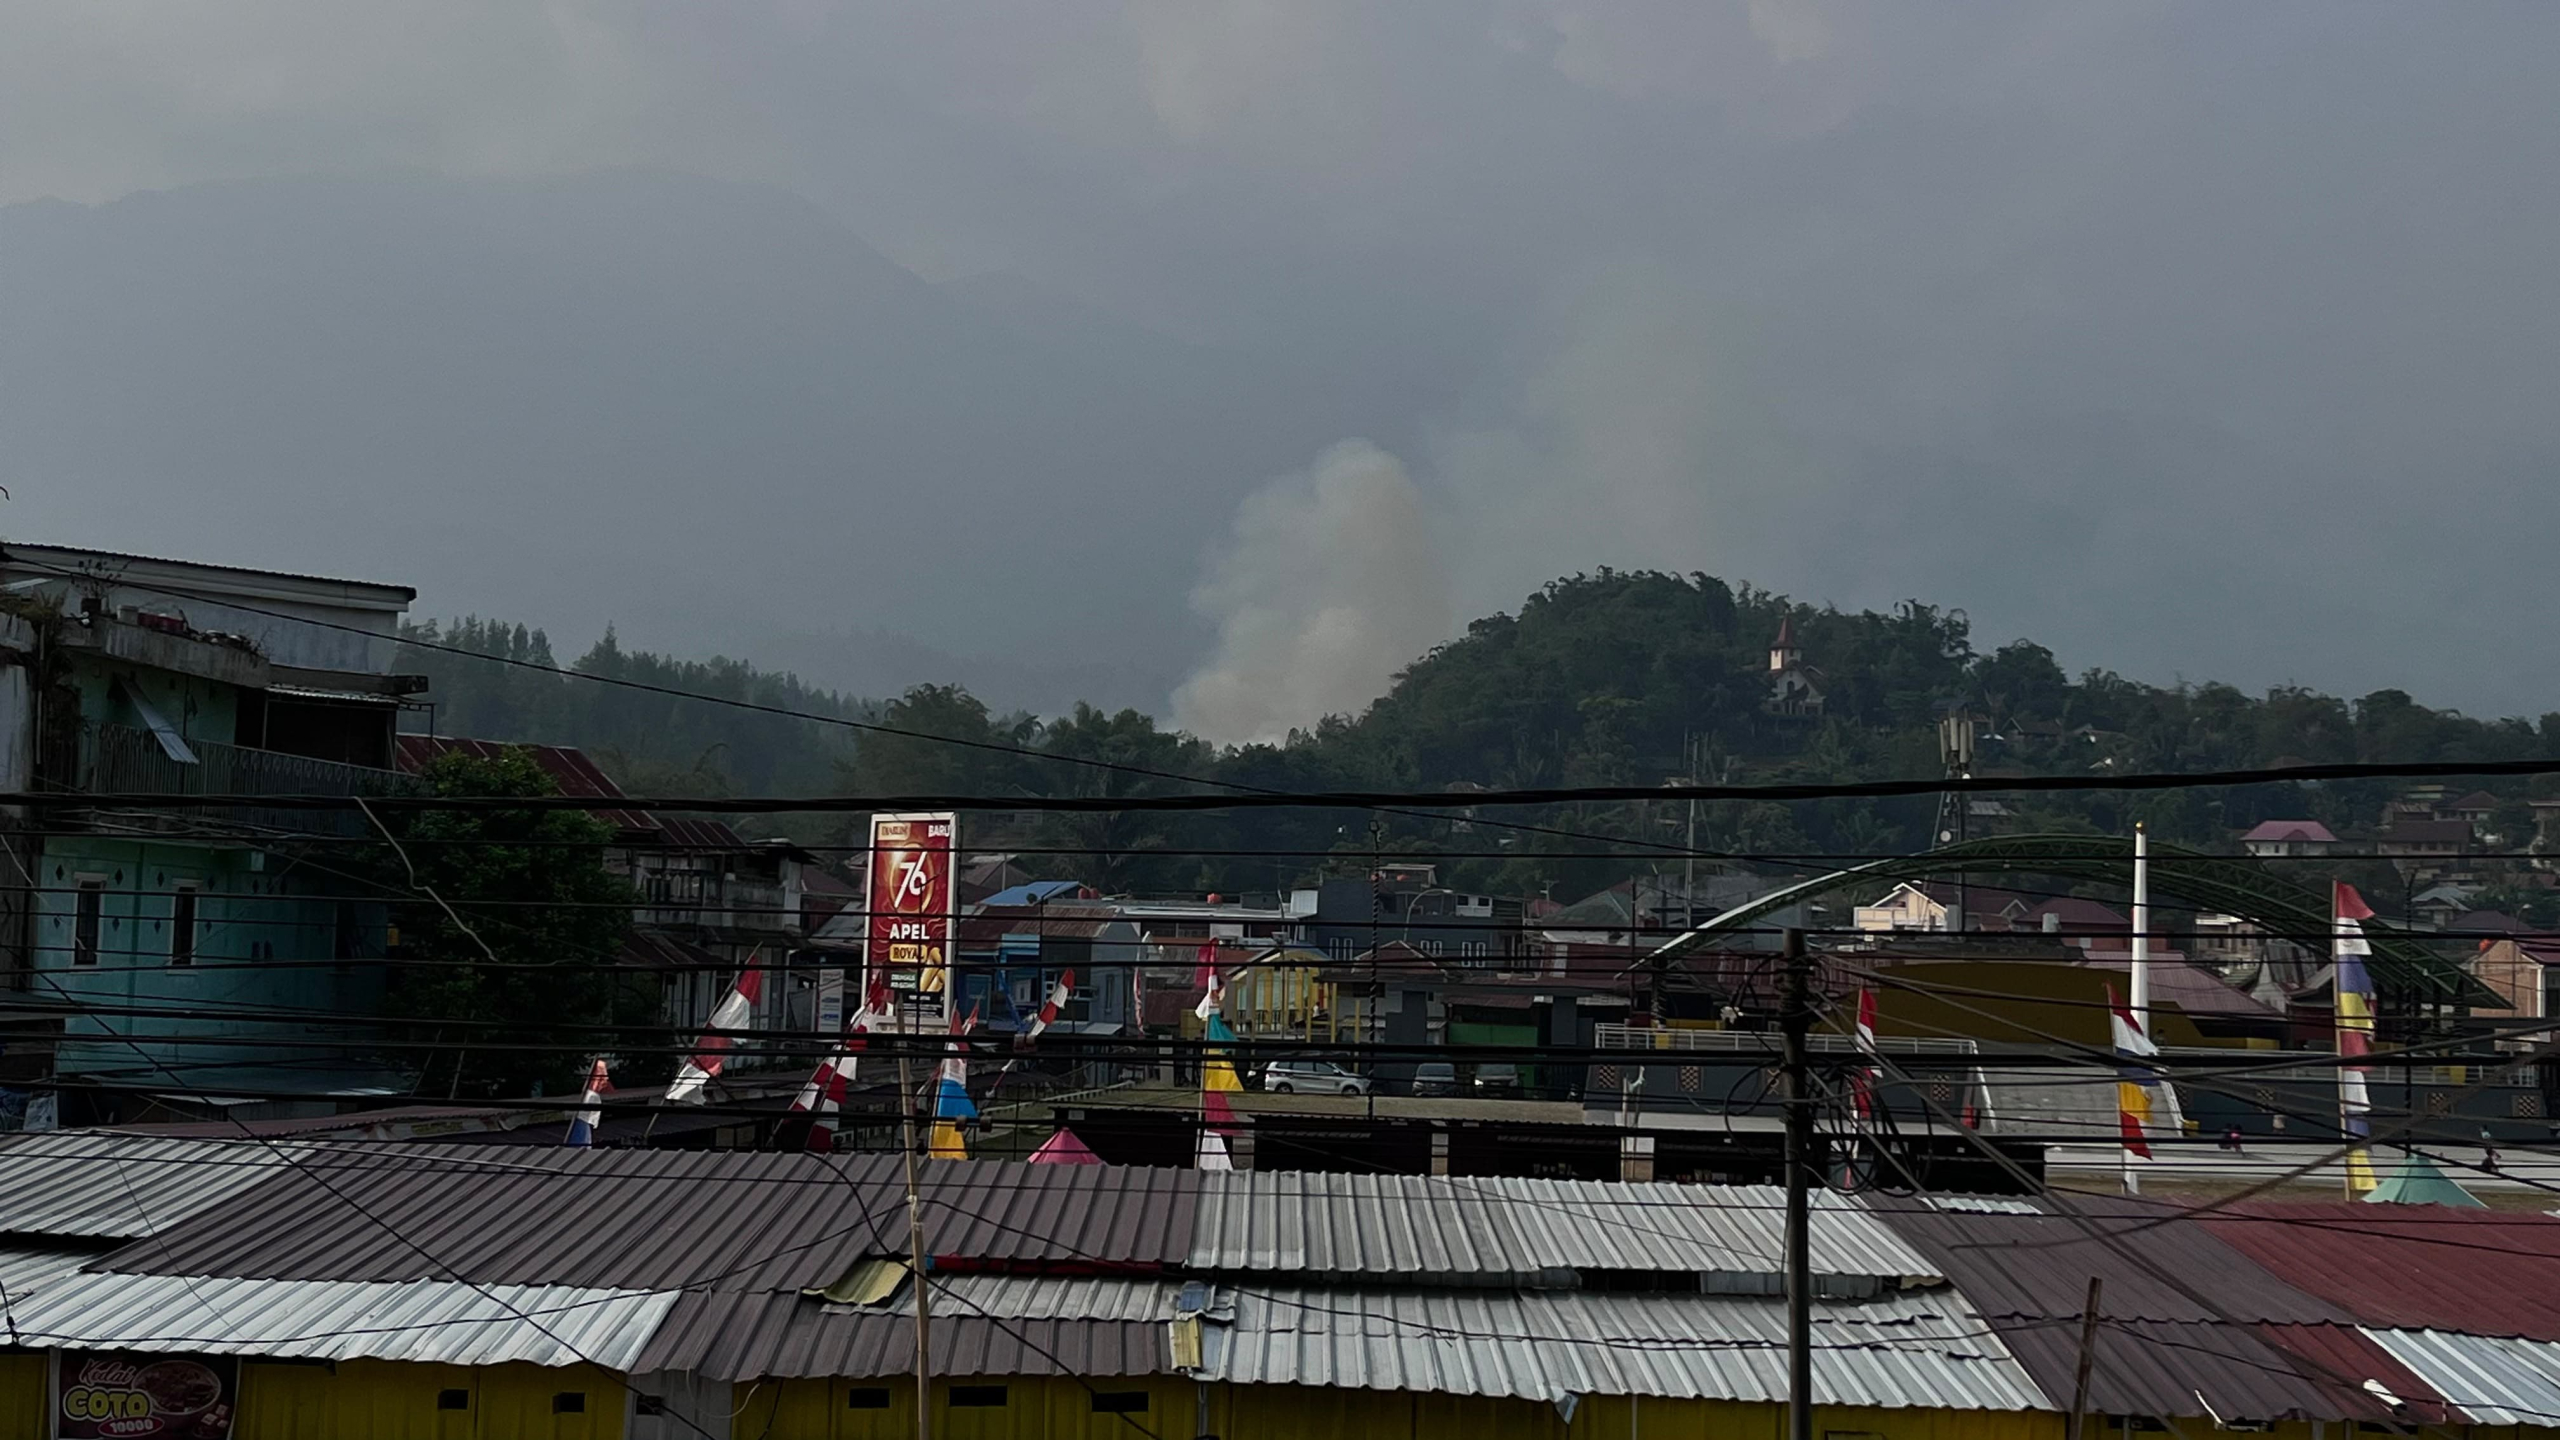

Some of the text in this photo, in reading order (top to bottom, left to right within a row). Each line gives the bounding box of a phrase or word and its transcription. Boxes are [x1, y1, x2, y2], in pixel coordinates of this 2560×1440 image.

[928, 825, 950, 837] BARU
[894, 851, 928, 908] 76
[889, 923, 930, 940] APEL
[79, 1358, 136, 1386] Kedai
[64, 1388, 150, 1420] COTO
[110, 1419, 154, 1433] 10000
